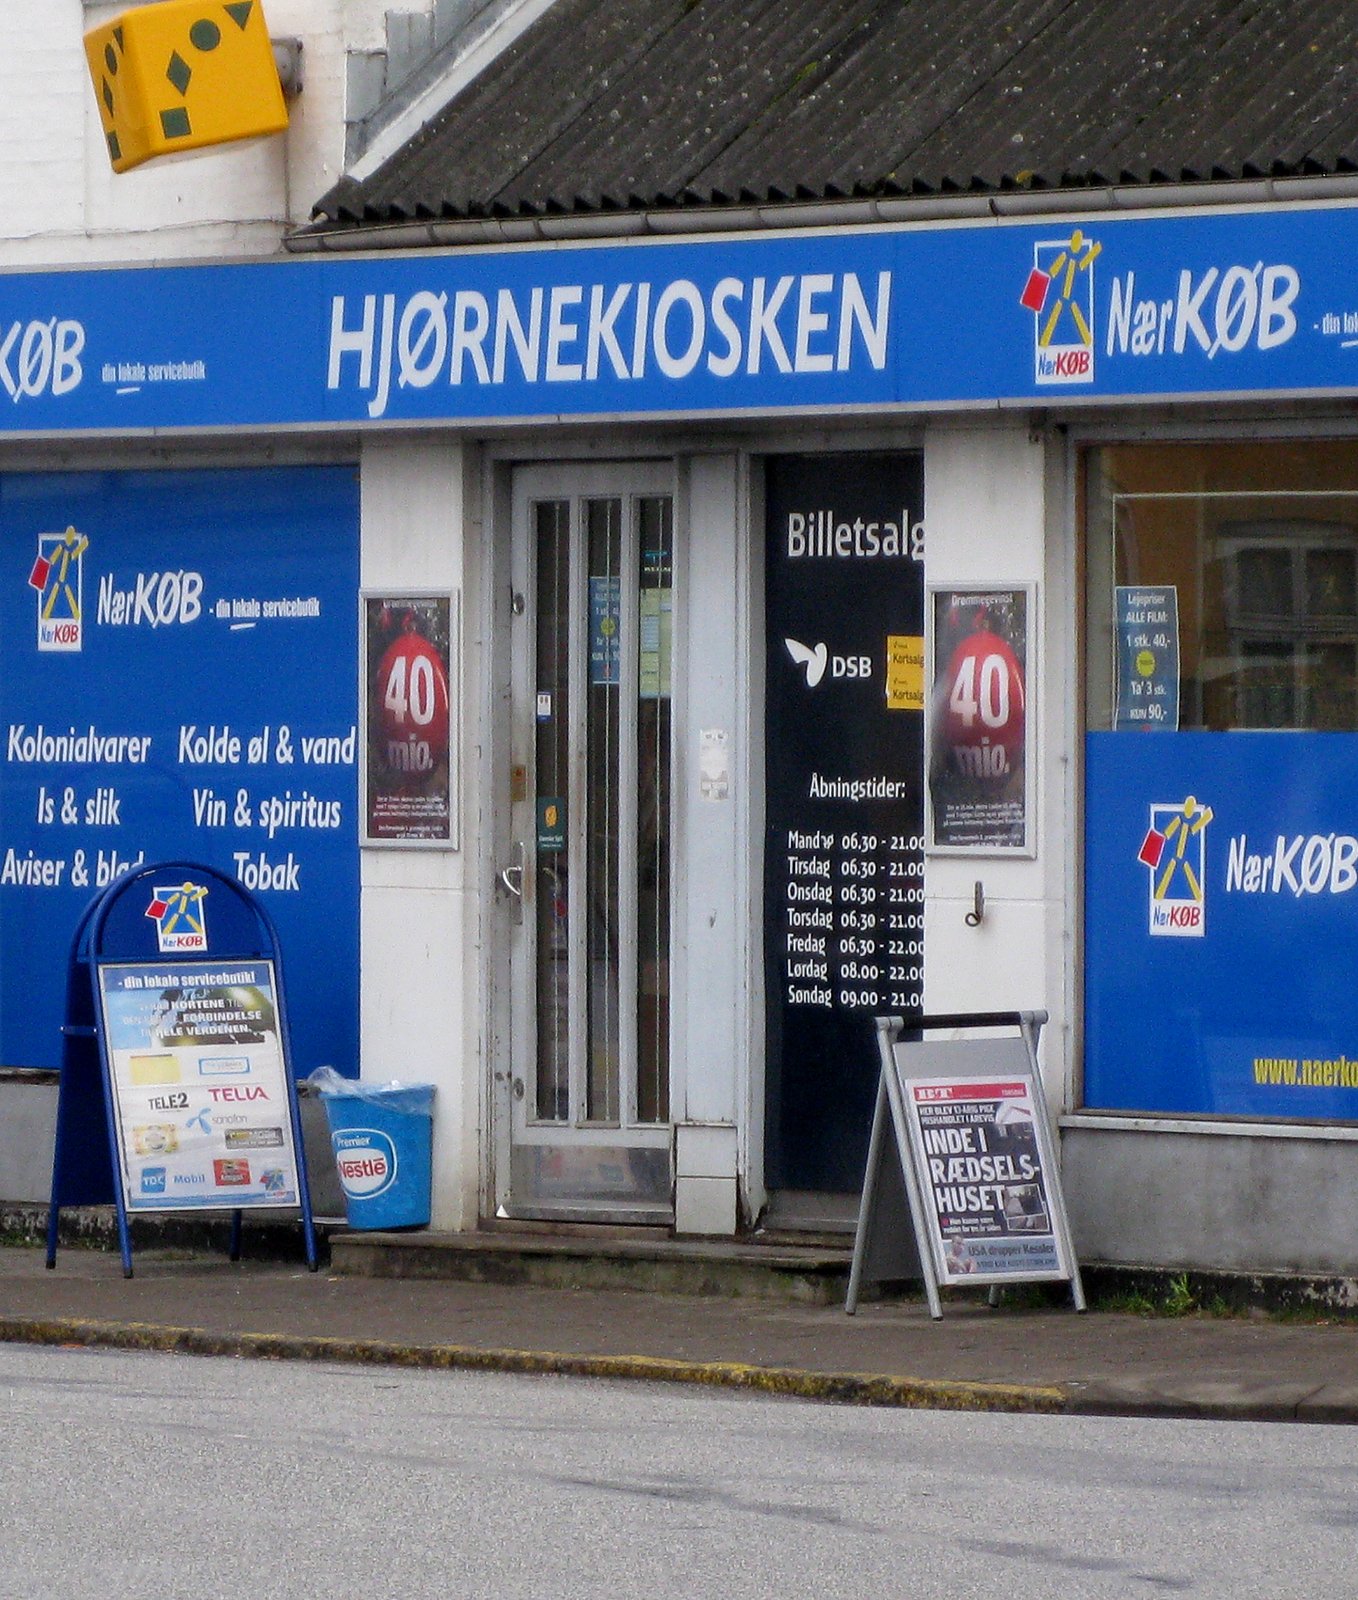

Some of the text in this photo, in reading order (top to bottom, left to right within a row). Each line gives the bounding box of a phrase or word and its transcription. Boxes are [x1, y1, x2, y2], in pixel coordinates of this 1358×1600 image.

[1106, 260, 1300, 360] NærKØB
[327, 271, 892, 418] HJØRNEKIOSKEN
[102, 359, 206, 382] din lokale servicebutik
[787, 508, 925, 561] Billetsalg
[97, 569, 204, 629] NærKØB
[215, 598, 231, 618] din
[232, 598, 261, 618] lokale
[262, 597, 320, 617] servicebutik
[1125, 611, 1146, 624] ALLE
[1126, 634, 1132, 647] 1
[832, 656, 872, 678] DSB
[384, 654, 436, 726] 40
[950, 653, 1010, 728] 40
[1146, 681, 1153, 696] 3
[7, 725, 151, 763] Kolonialvarer
[178, 725, 356, 764] Kolde øl & vand
[388, 733, 434, 771] mio.
[953, 736, 1011, 778] mio.
[809, 772, 906, 802] Åbningstider:
[38, 787, 121, 825] Is & slik
[193, 788, 226, 827] Vin
[233, 788, 252, 827] &
[259, 790, 341, 838] spiritus
[841, 832, 877, 852] 06.30
[1, 848, 65, 886] Aviser
[71, 849, 89, 887] &
[233, 852, 300, 891] Tobak
[787, 856, 831, 878] Tirsdag
[841, 858, 877, 878] 06.30
[1226, 832, 1358, 898] NærKØB
[787, 881, 833, 904] Onsdag
[840, 884, 876, 904] 06.30
[787, 907, 833, 931] Torsdag
[840, 910, 876, 930] 06.30
[1153, 906, 1200, 928] NærKØB
[787, 933, 826, 956] Fredag
[840, 936, 875, 956] 06.30
[124, 977, 143, 989] din
[144, 974, 180, 988] lokale
[181, 971, 256, 987] servicebutik!
[787, 959, 828, 982] Lørdag
[840, 961, 878, 979] 08.00
[170, 999, 225, 1010] KORTENE
[788, 985, 832, 1008] Søndag
[840, 990, 878, 1008] 09.00
[182, 1011, 262, 1023] FORBINDELSE
[148, 1092, 189, 1110] TELE2
[208, 1086, 271, 1102] TELIA
[924, 1126, 988, 1155] INDE I
[143, 1173, 205, 1187] TDC Mobil
[929, 1154, 1040, 1184] RÆDSELS-
[935, 1185, 1005, 1214] HUSET
[968, 1246, 987, 1256] USA
